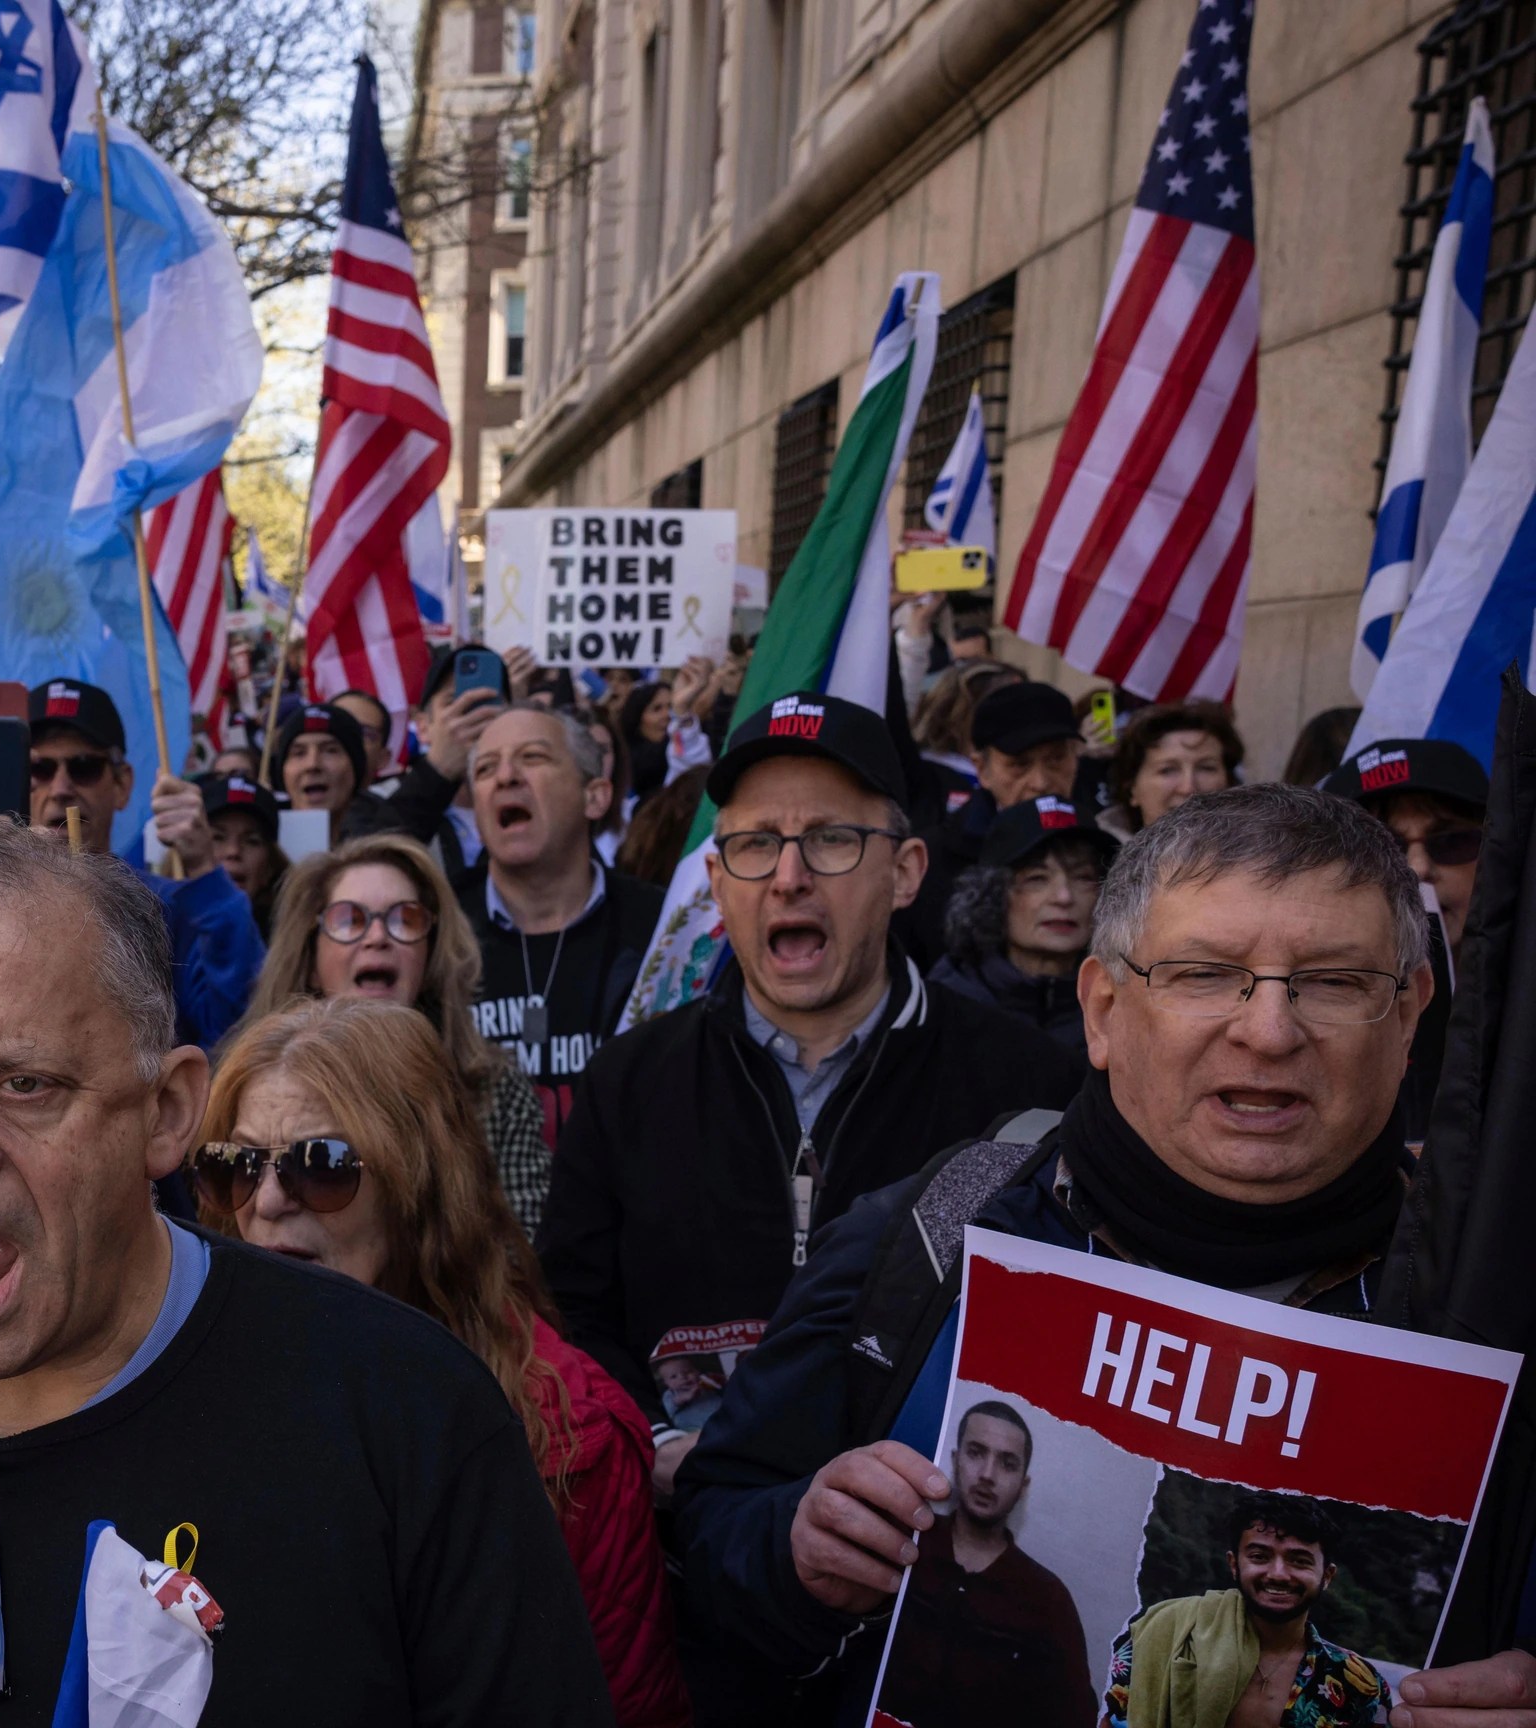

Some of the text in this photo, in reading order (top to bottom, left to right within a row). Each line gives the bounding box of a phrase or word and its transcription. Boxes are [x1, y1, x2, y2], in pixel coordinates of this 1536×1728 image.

[551, 518, 683, 547] BRING
[549, 556, 673, 586] THEM
[547, 593, 671, 623] HOME
[546, 628, 663, 663] NOW!
[768, 714, 824, 737] NOW
[1360, 759, 1409, 790] NOW
[467, 994, 545, 1037] RIN
[662, 1322, 768, 1345] IDNAPPE
[1081, 1311, 1317, 1459] HELP!
